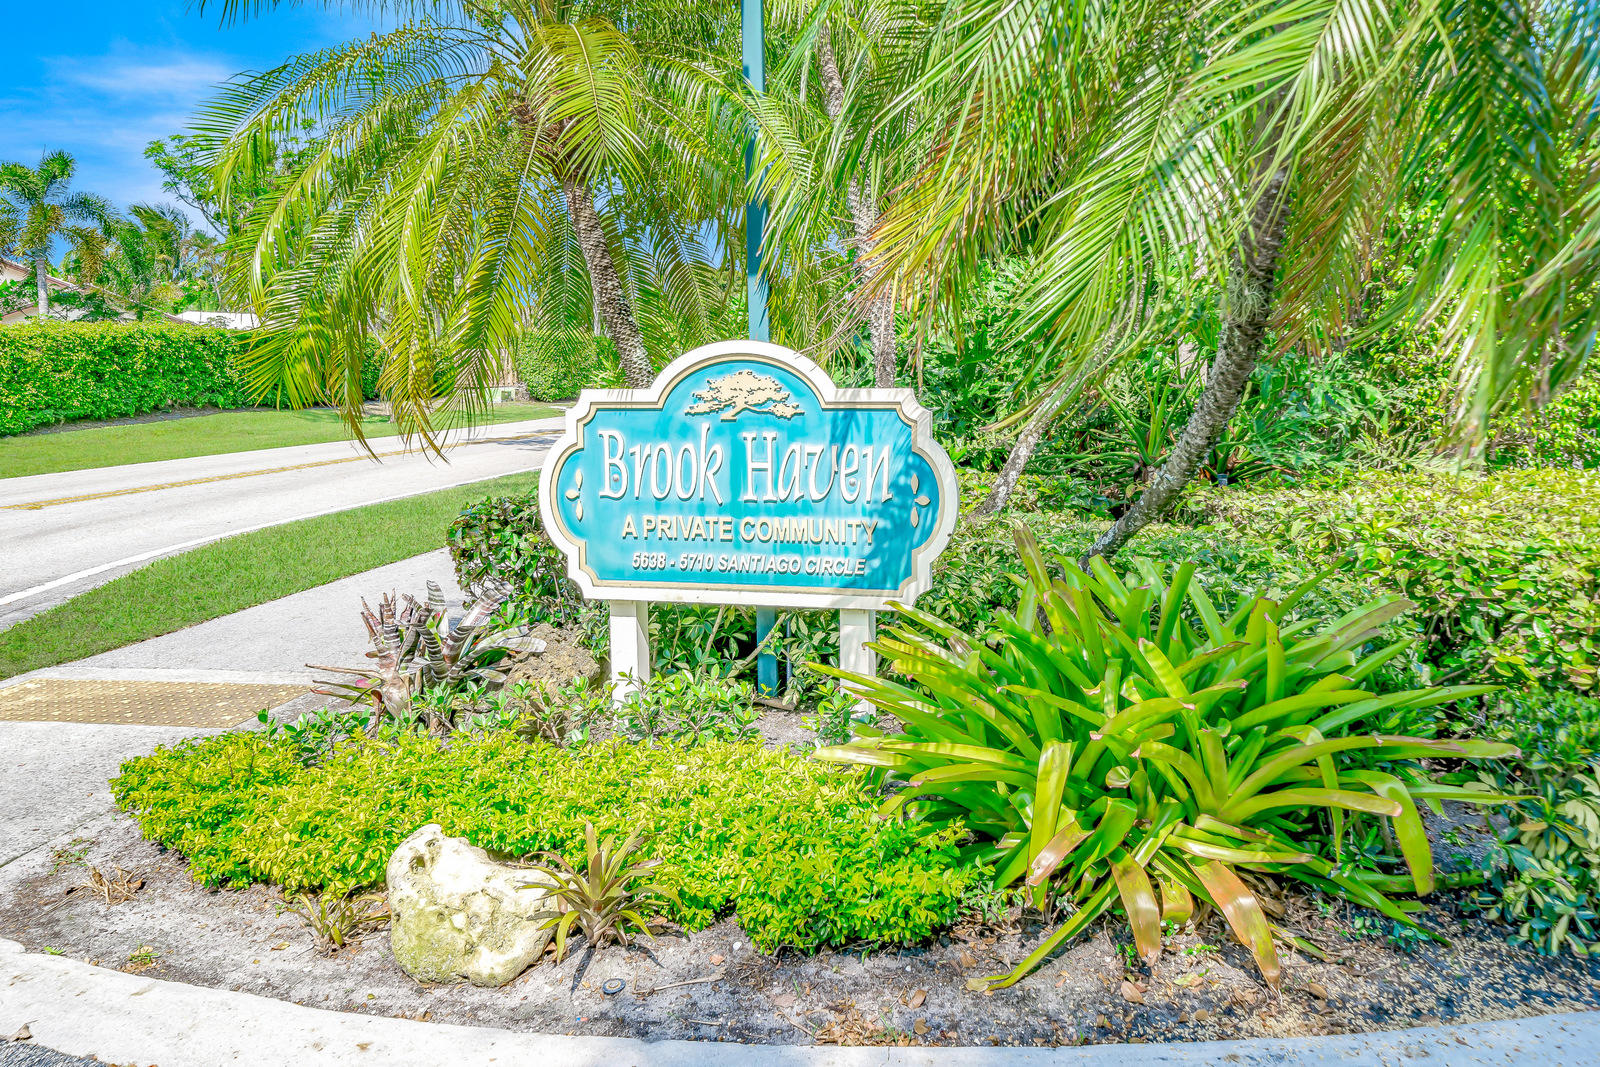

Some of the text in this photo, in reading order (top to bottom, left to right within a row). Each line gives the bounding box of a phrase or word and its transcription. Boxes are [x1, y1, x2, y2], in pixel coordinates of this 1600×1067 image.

[598, 423, 894, 506] Brook Haven
[622, 515, 878, 545] A PRIVATE COMMUNITY
[632, 553, 666, 571] 5638
[679, 554, 713, 572] 5710
[717, 554, 801, 575] SANTIAGO
[804, 558, 866, 577] CIRCLE
